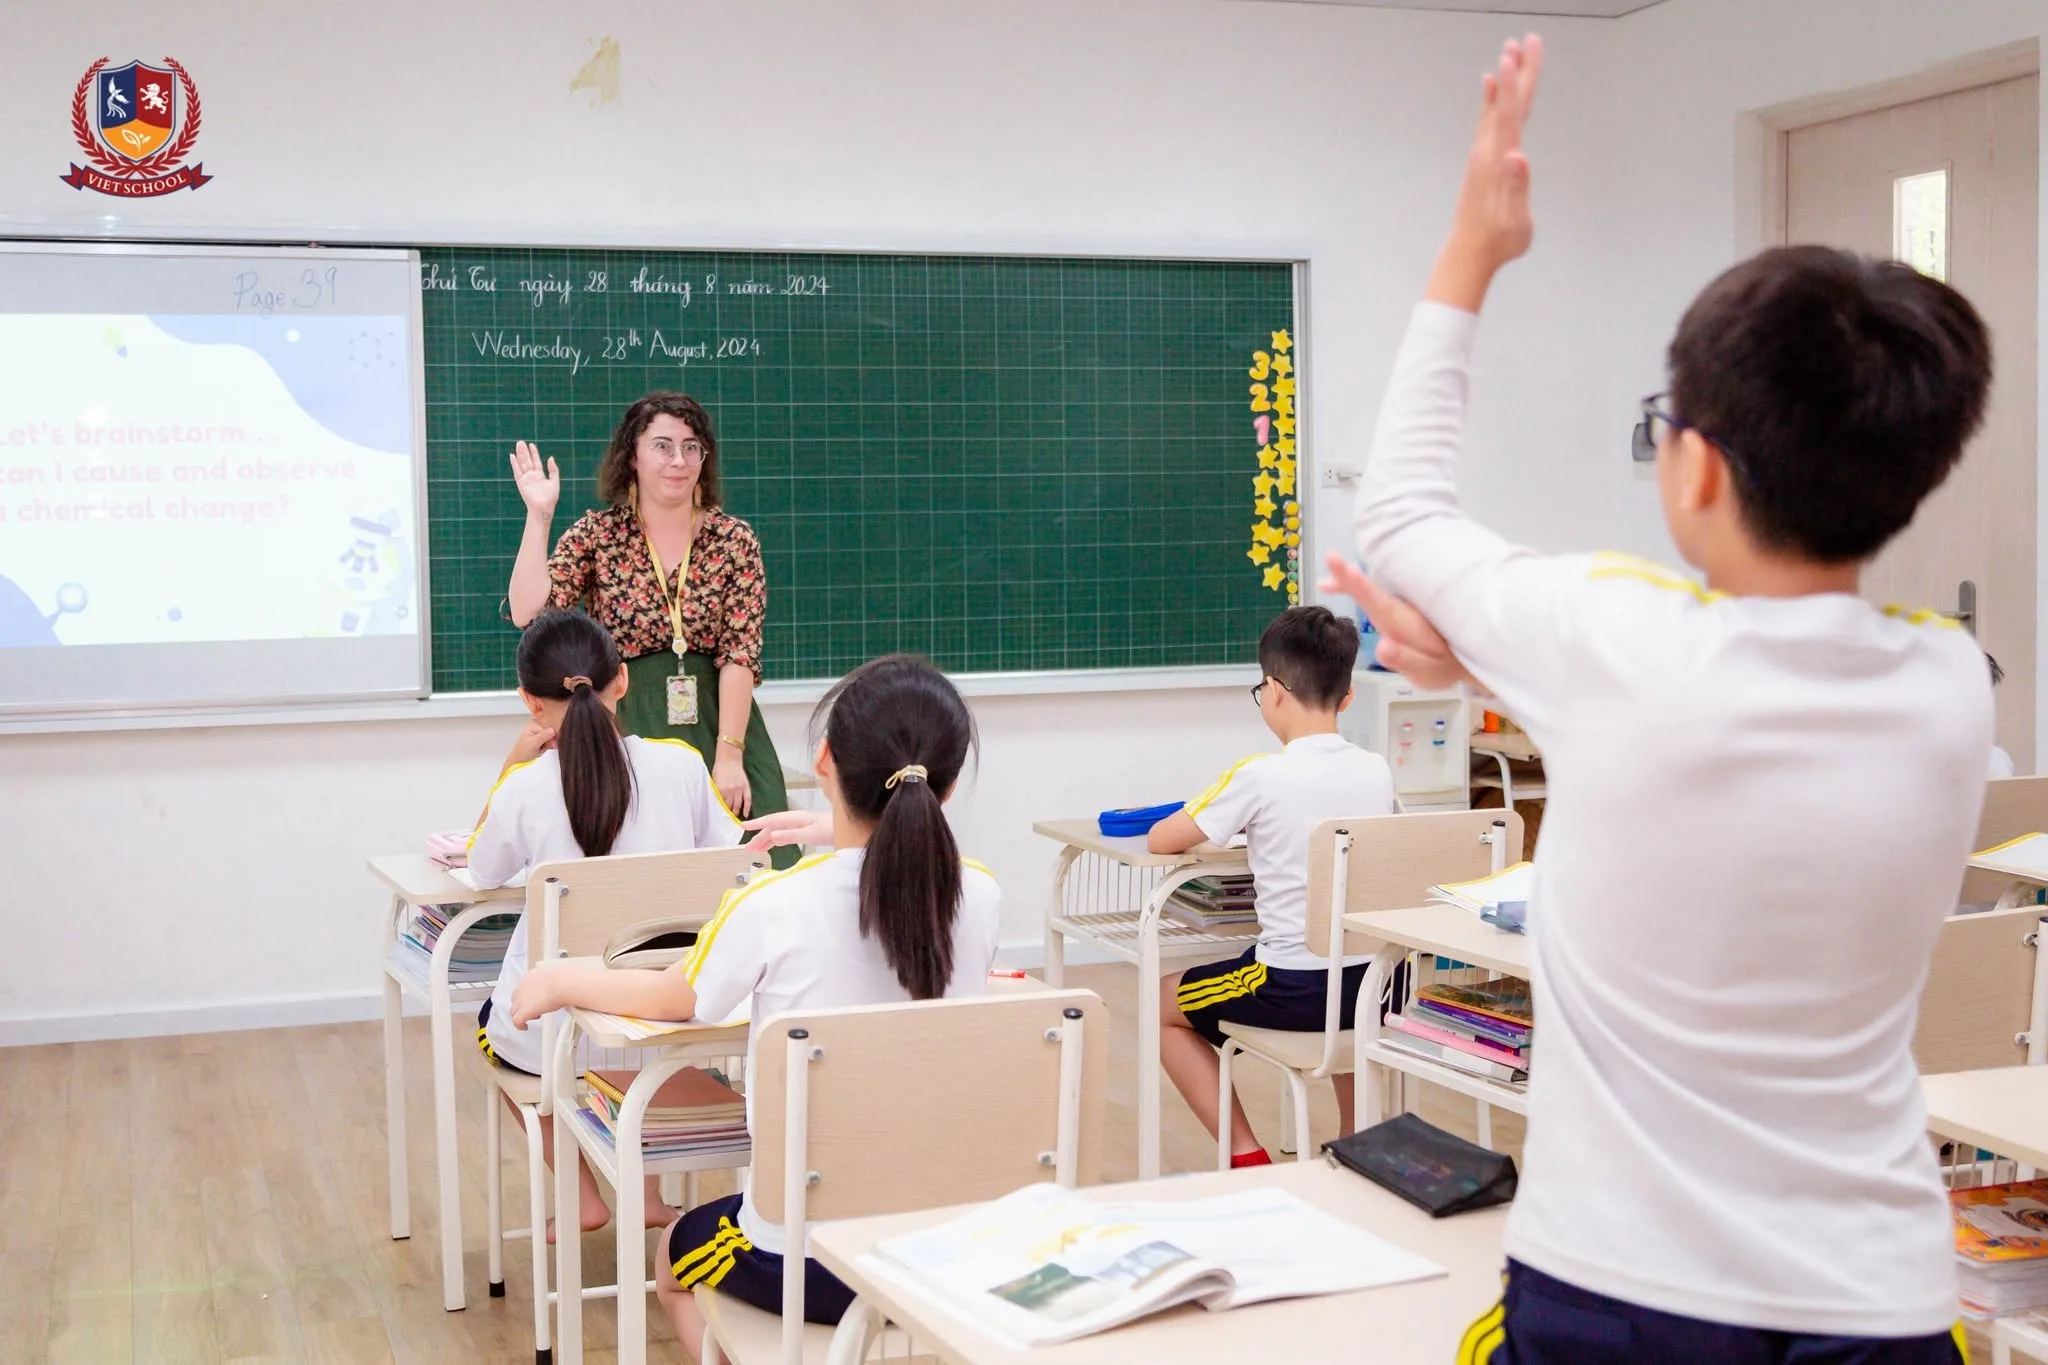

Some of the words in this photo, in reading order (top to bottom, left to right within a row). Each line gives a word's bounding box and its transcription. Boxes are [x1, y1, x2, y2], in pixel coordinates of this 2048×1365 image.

[233, 270, 287, 320] Page
[292, 266, 337, 309] 39
[519, 274, 573, 308] ngày
[583, 270, 607, 293] 28
[630, 266, 692, 309] tháng
[705, 273, 716, 295] 8
[728, 279, 775, 295] năm
[780, 274, 832, 296] 2024
[471, 329, 590, 376] Wednesday,
[601, 327, 642, 360] 28th
[1249, 350, 1271, 381] 3
[1249, 382, 1271, 412] 2
[1253, 414, 1270, 447] 1
[55, 458, 63, 485] I
[73, 463, 163, 485] cause
[172, 455, 227, 484] and
[235, 455, 357, 484] observe
[17, 492, 156, 524] chemical
[164, 492, 290, 526] change?
